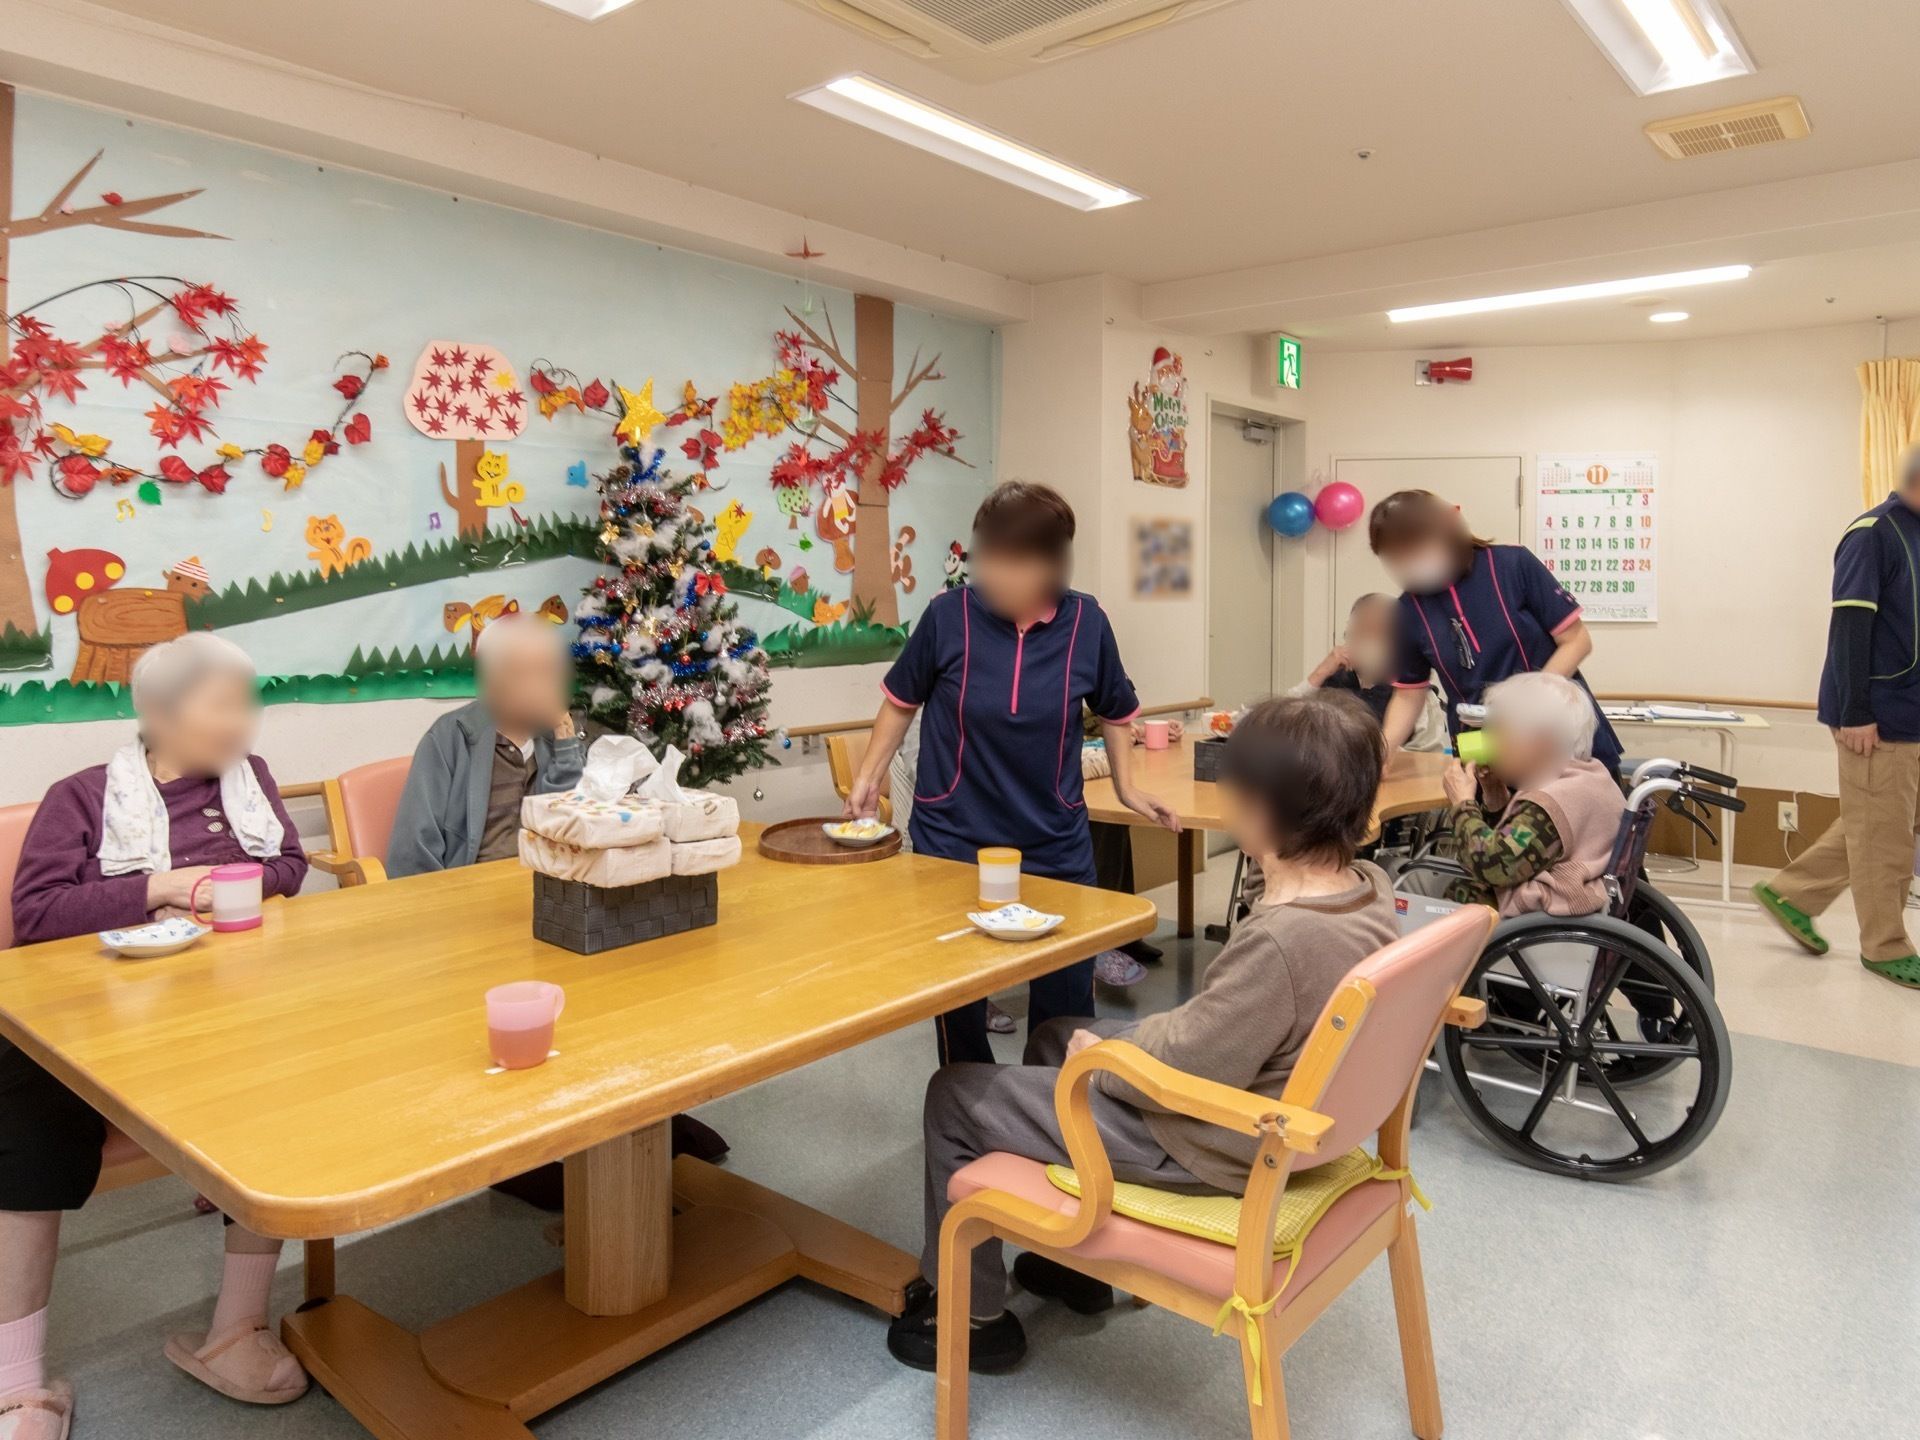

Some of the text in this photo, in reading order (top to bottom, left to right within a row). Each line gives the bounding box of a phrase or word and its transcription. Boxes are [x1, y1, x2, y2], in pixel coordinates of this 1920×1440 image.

[1154, 392, 1181, 413] Merry
[1590, 466, 1604, 483] 11
[1611, 494, 1648, 506] 1 2 3
[1546, 516, 1651, 528] 4 5 6 7 8 9 10
[1545, 537, 1651, 549] 11 12 13 14 15 16 17
[1544, 559, 1651, 571] 18 19 20 21 22 23 24
[1575, 581, 1586, 592] 27
[1590, 581, 1602, 592] 28
[1606, 581, 1618, 592] 29
[1622, 581, 1634, 592] 30
